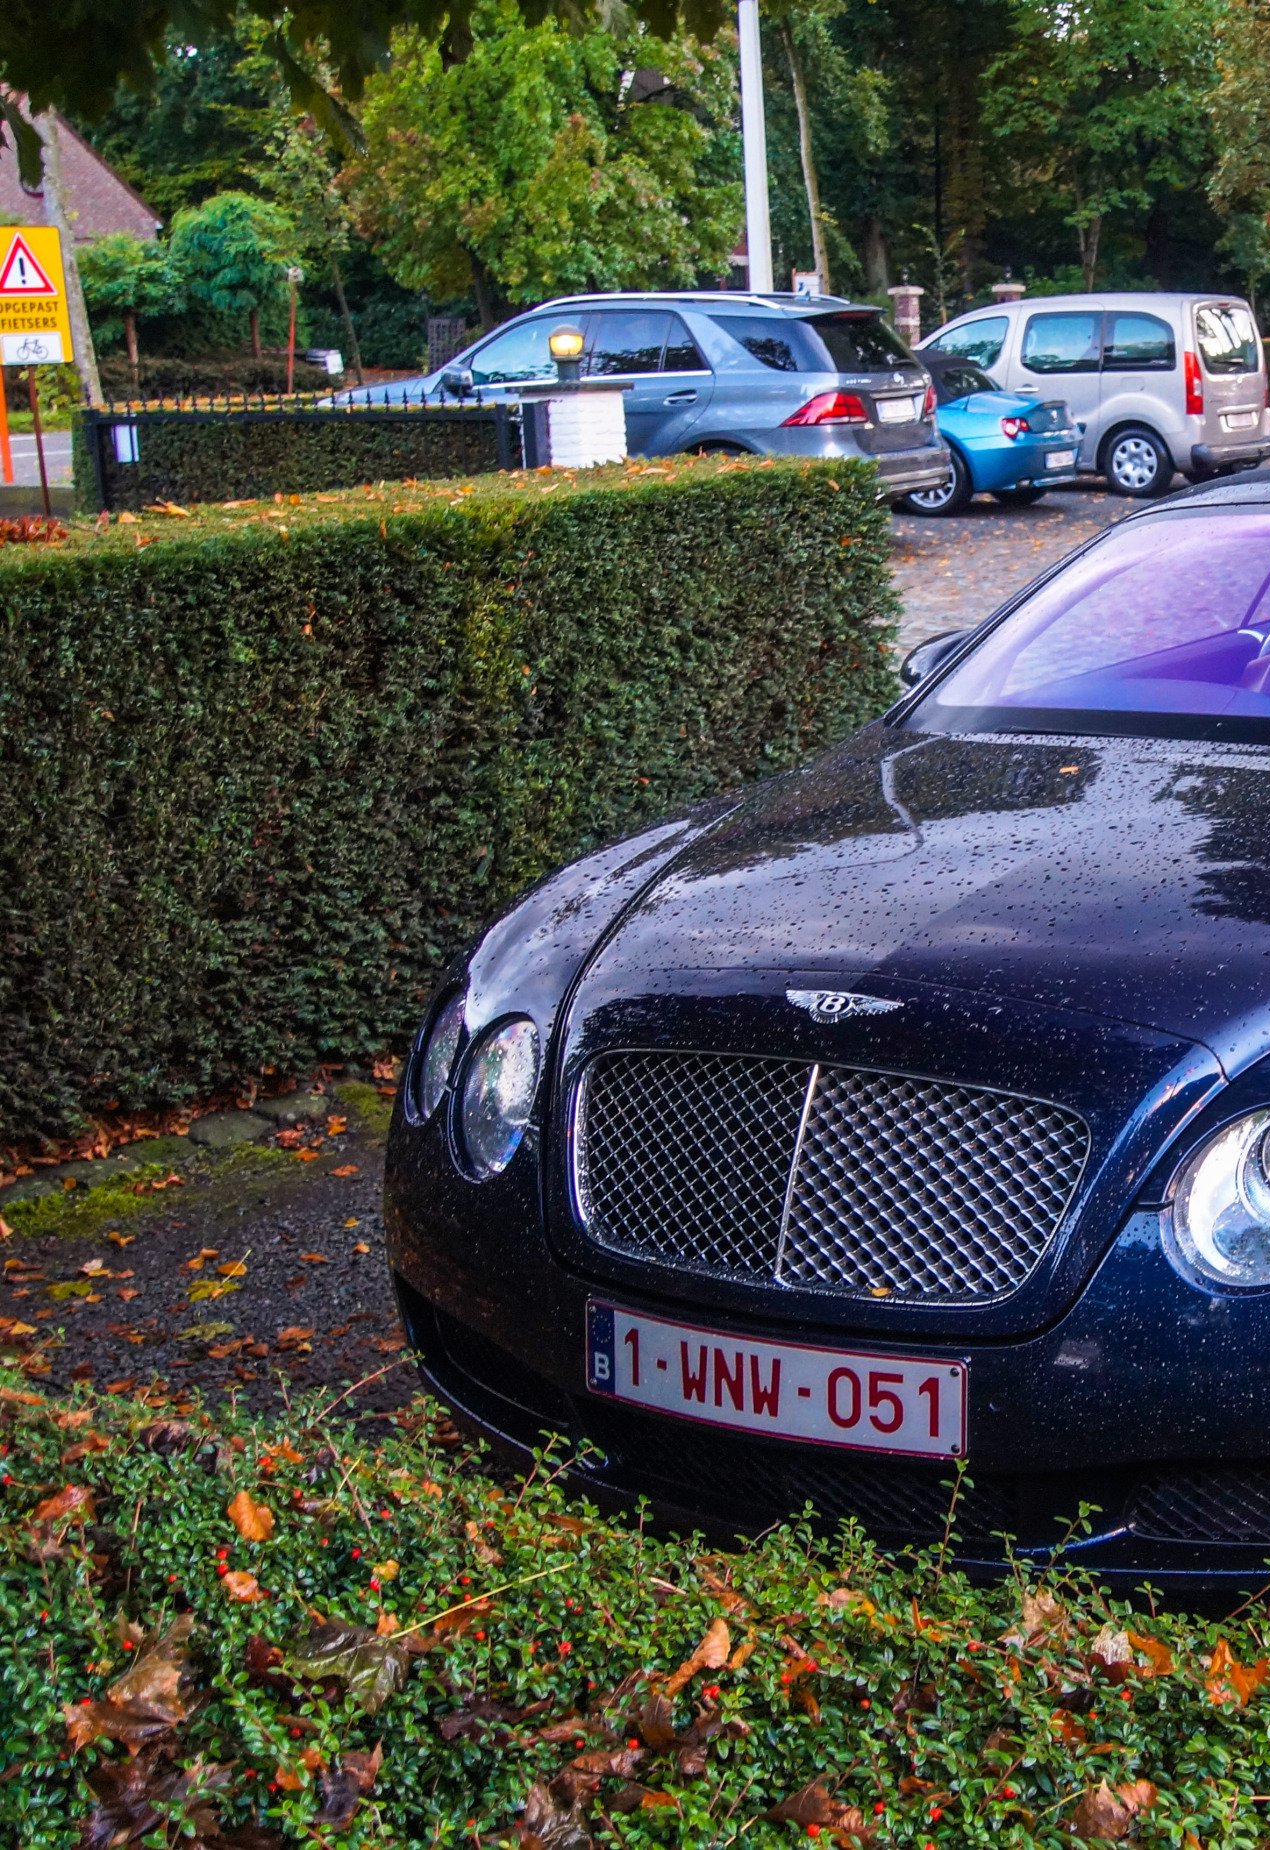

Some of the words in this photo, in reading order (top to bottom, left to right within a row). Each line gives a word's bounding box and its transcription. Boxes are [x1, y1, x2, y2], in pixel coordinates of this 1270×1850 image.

[1, 317, 57, 330] FIETSERS
[594, 1351, 610, 1380] B
[624, 1327, 940, 1438] 1-WNW-051
